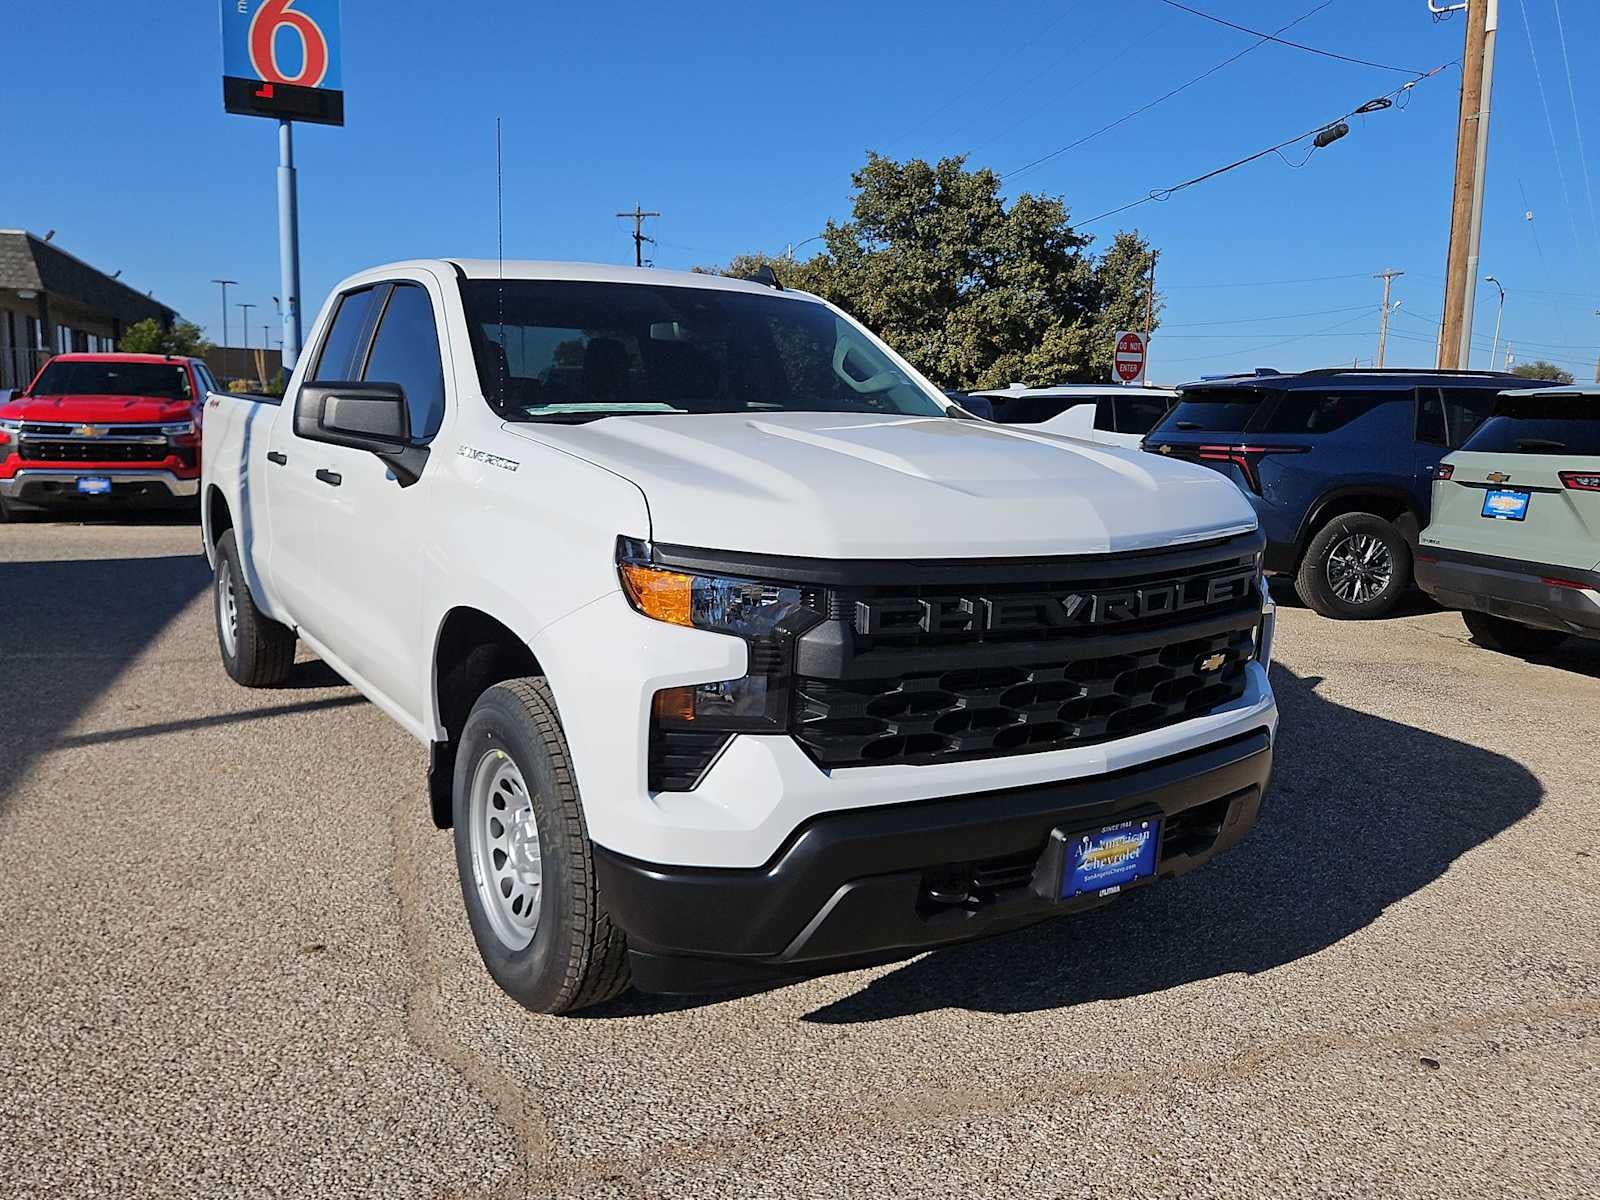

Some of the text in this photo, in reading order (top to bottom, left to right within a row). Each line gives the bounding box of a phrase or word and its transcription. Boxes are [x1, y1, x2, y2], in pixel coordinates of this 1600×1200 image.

[248, 0, 328, 88] 6
[1119, 342, 1141, 351] DO NOT
[1120, 364, 1137, 373] ENTER
[1083, 847, 1141, 871] Chevrolet
